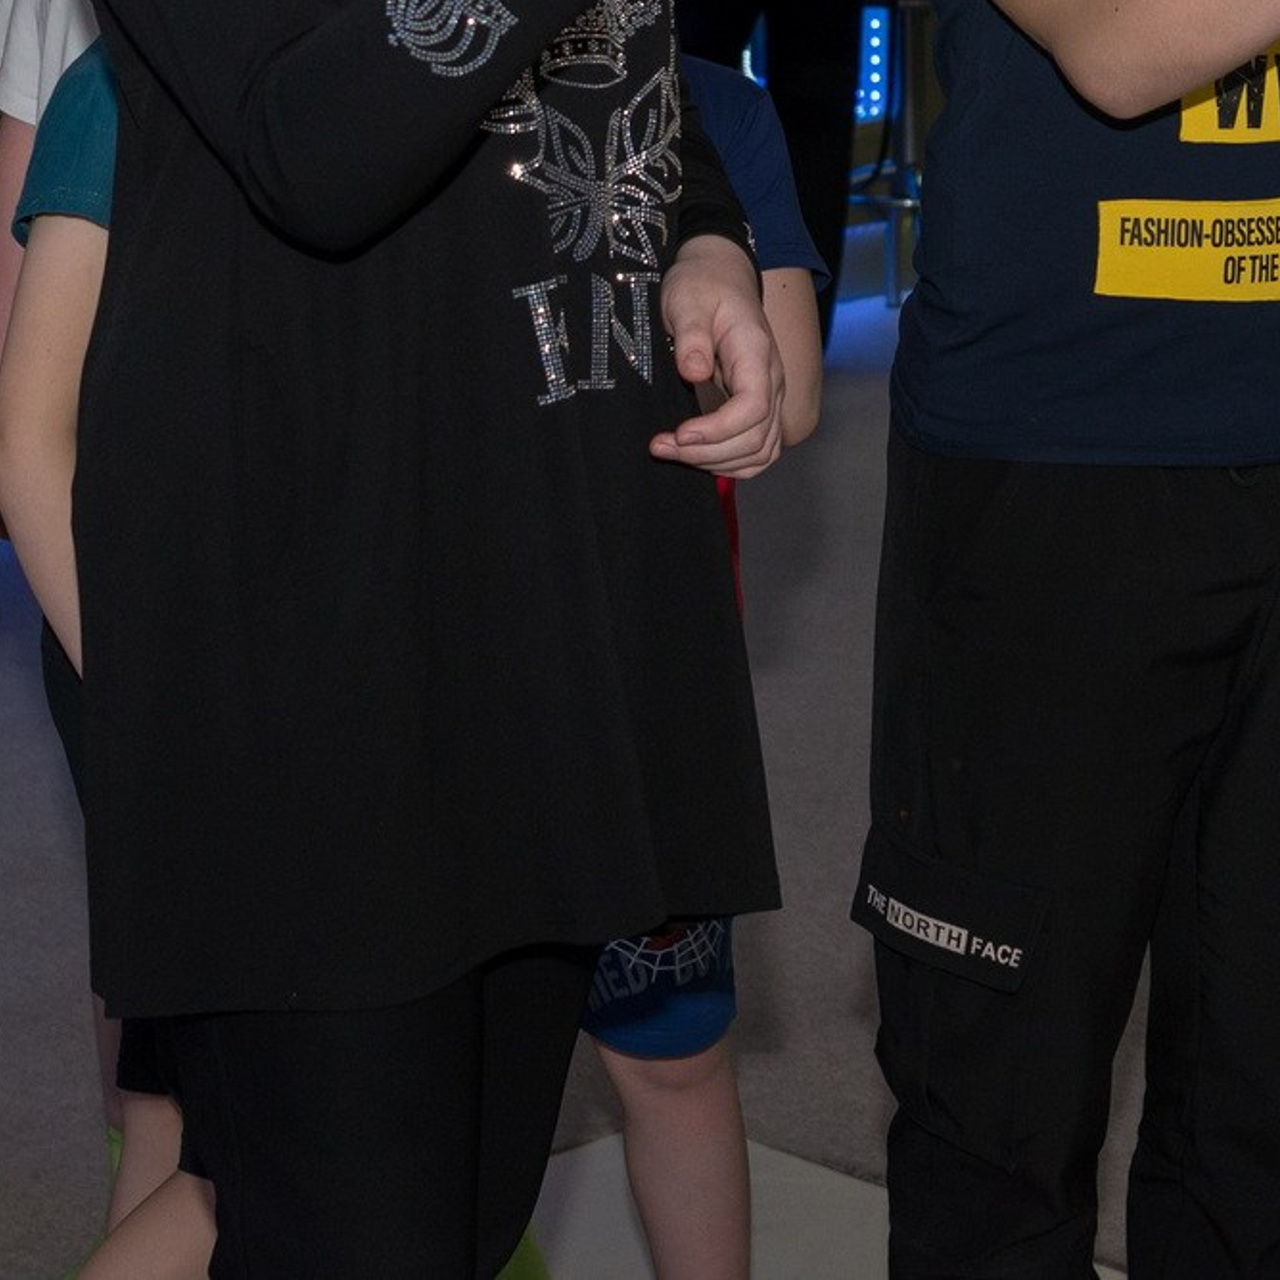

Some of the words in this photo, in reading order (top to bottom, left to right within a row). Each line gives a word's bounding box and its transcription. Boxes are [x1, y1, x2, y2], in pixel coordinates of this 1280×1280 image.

[1223, 255, 1246, 285] OF
[1248, 253, 1280, 283] THE
[867, 884, 888, 916] THE
[888, 902, 963, 951] NORTH
[970, 935, 1023, 969] FACE
